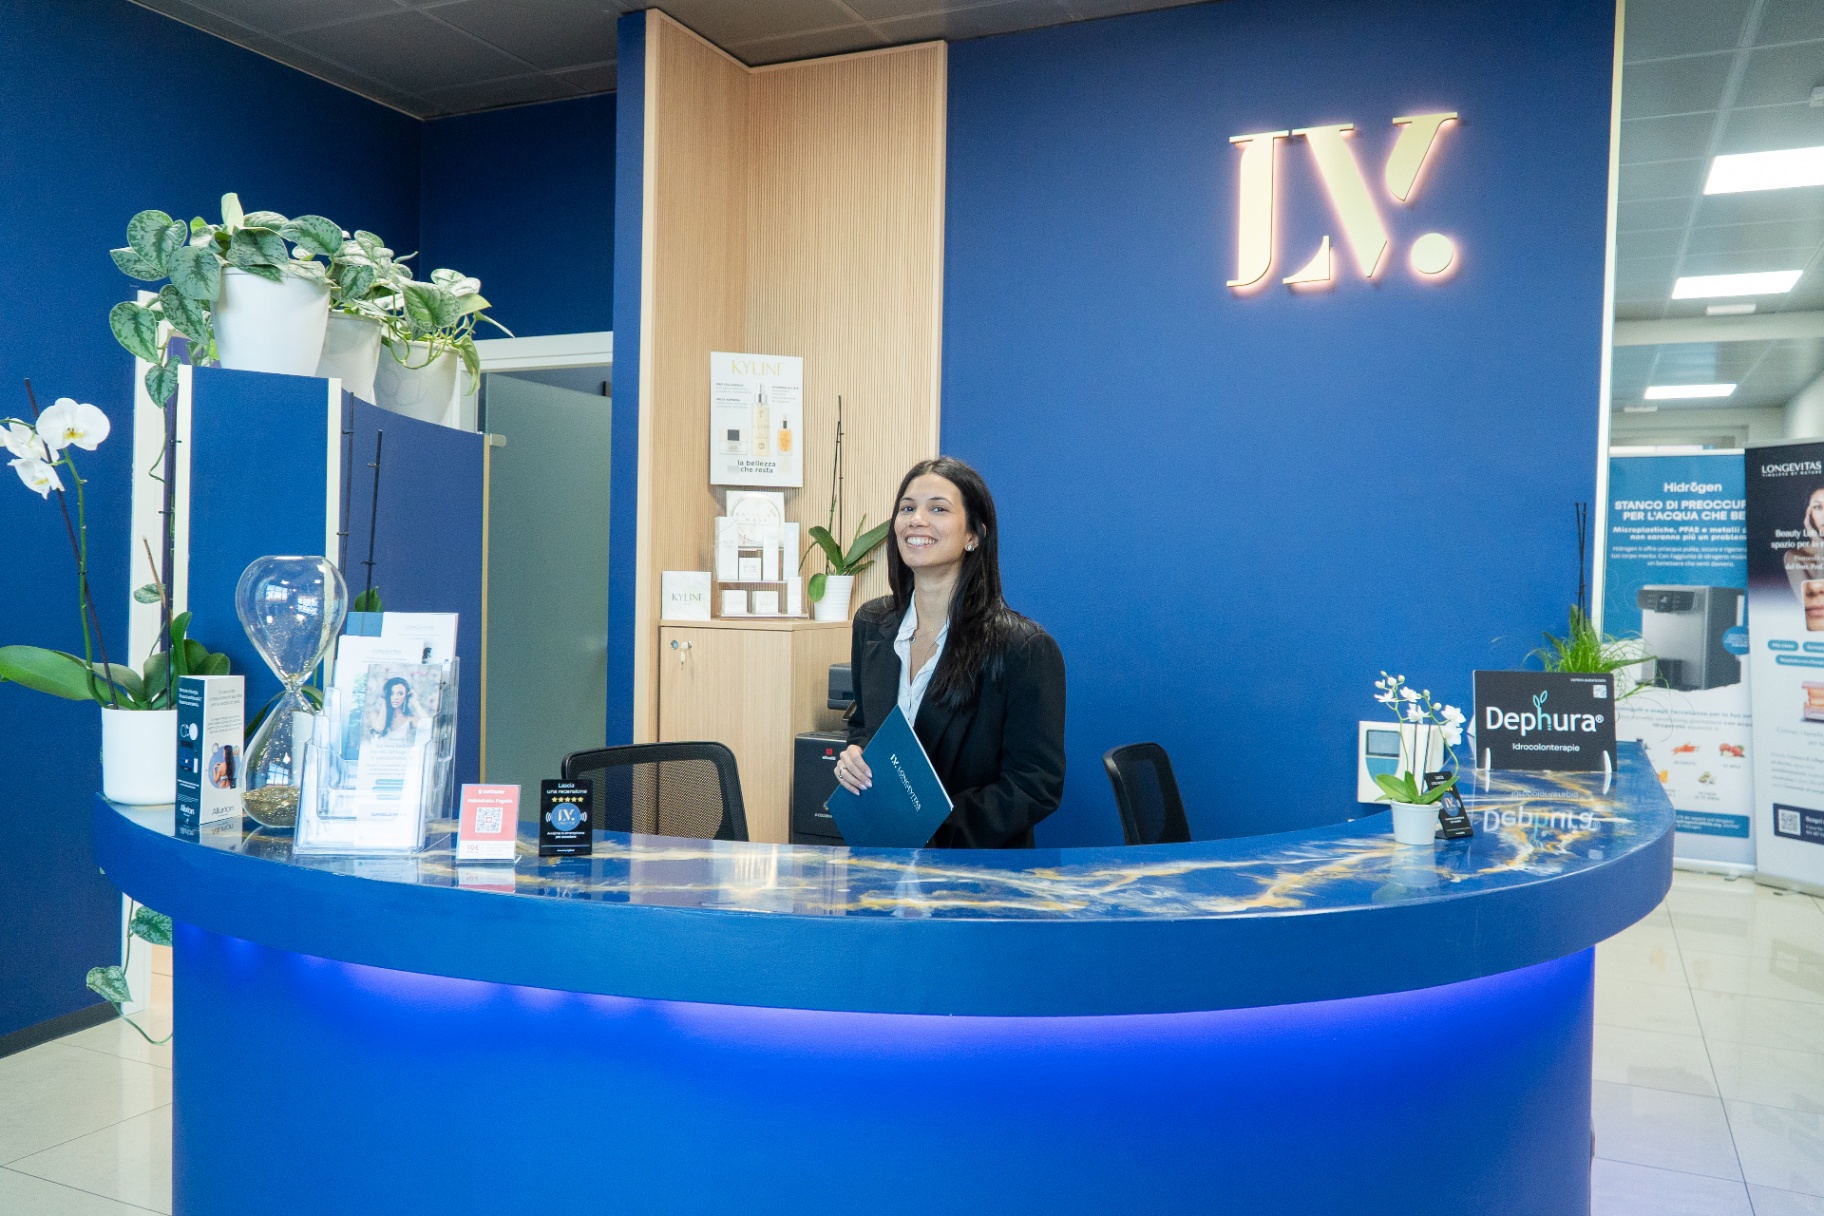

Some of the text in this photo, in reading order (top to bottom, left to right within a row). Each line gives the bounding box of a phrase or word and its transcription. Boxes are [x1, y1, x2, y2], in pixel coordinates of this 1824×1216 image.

[1761, 461, 1822, 474] LONGEVITAS
[1614, 500, 1663, 510] STANCO
[1666, 500, 1678, 510] DI
[1623, 511, 1645, 520] PER
[1647, 511, 1699, 521] L'ACQUA
[1701, 511, 1728, 520] CHE
[1775, 528, 1802, 540] Beauty
[1771, 540, 1796, 550] spazio
[1797, 540, 1810, 550] per
[1512, 743, 1580, 752] Idrocolonterapie
[212, 805, 234, 816] Allurion
